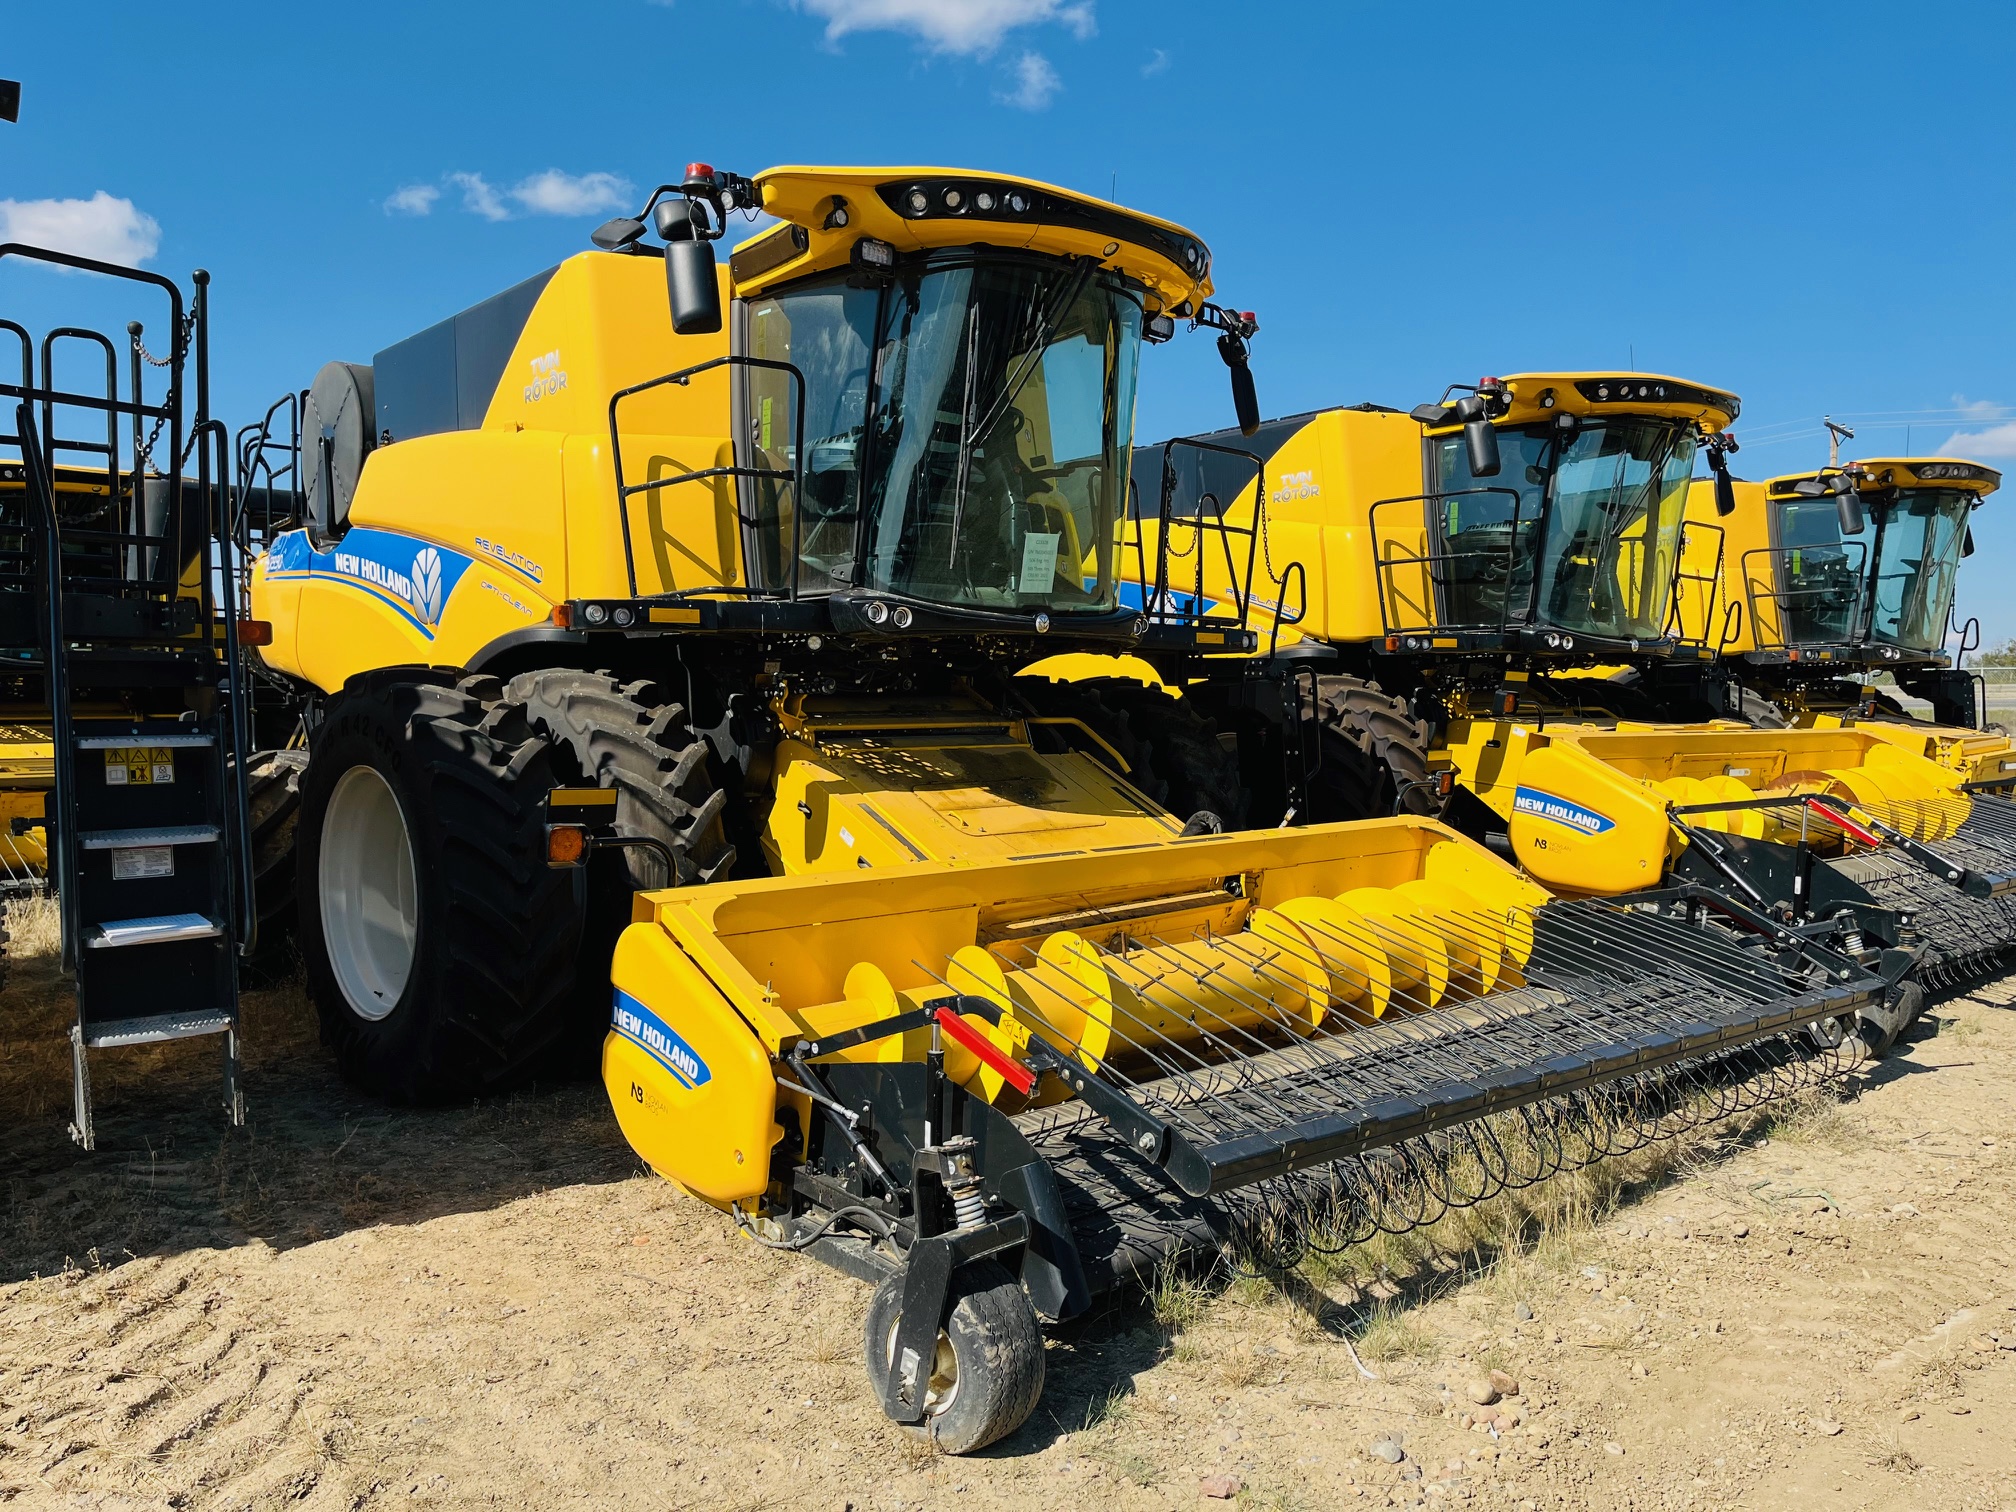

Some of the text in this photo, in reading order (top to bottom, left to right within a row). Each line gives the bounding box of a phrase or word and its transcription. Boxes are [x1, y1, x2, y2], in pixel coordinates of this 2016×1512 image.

[530, 349, 560, 376] TWIN
[524, 370, 568, 404] ROTOR
[1272, 484, 1320, 503] ROTOR
[1280, 470, 1312, 486] TWIN
[475, 537, 544, 578] REVELATION
[335, 552, 411, 601] NEW HOLLAND
[480, 581, 533, 617] OPTI-CLEAN
[1516, 796, 1601, 831] NEW HOLLAND
[613, 1006, 698, 1080] NEW HOLLAND
